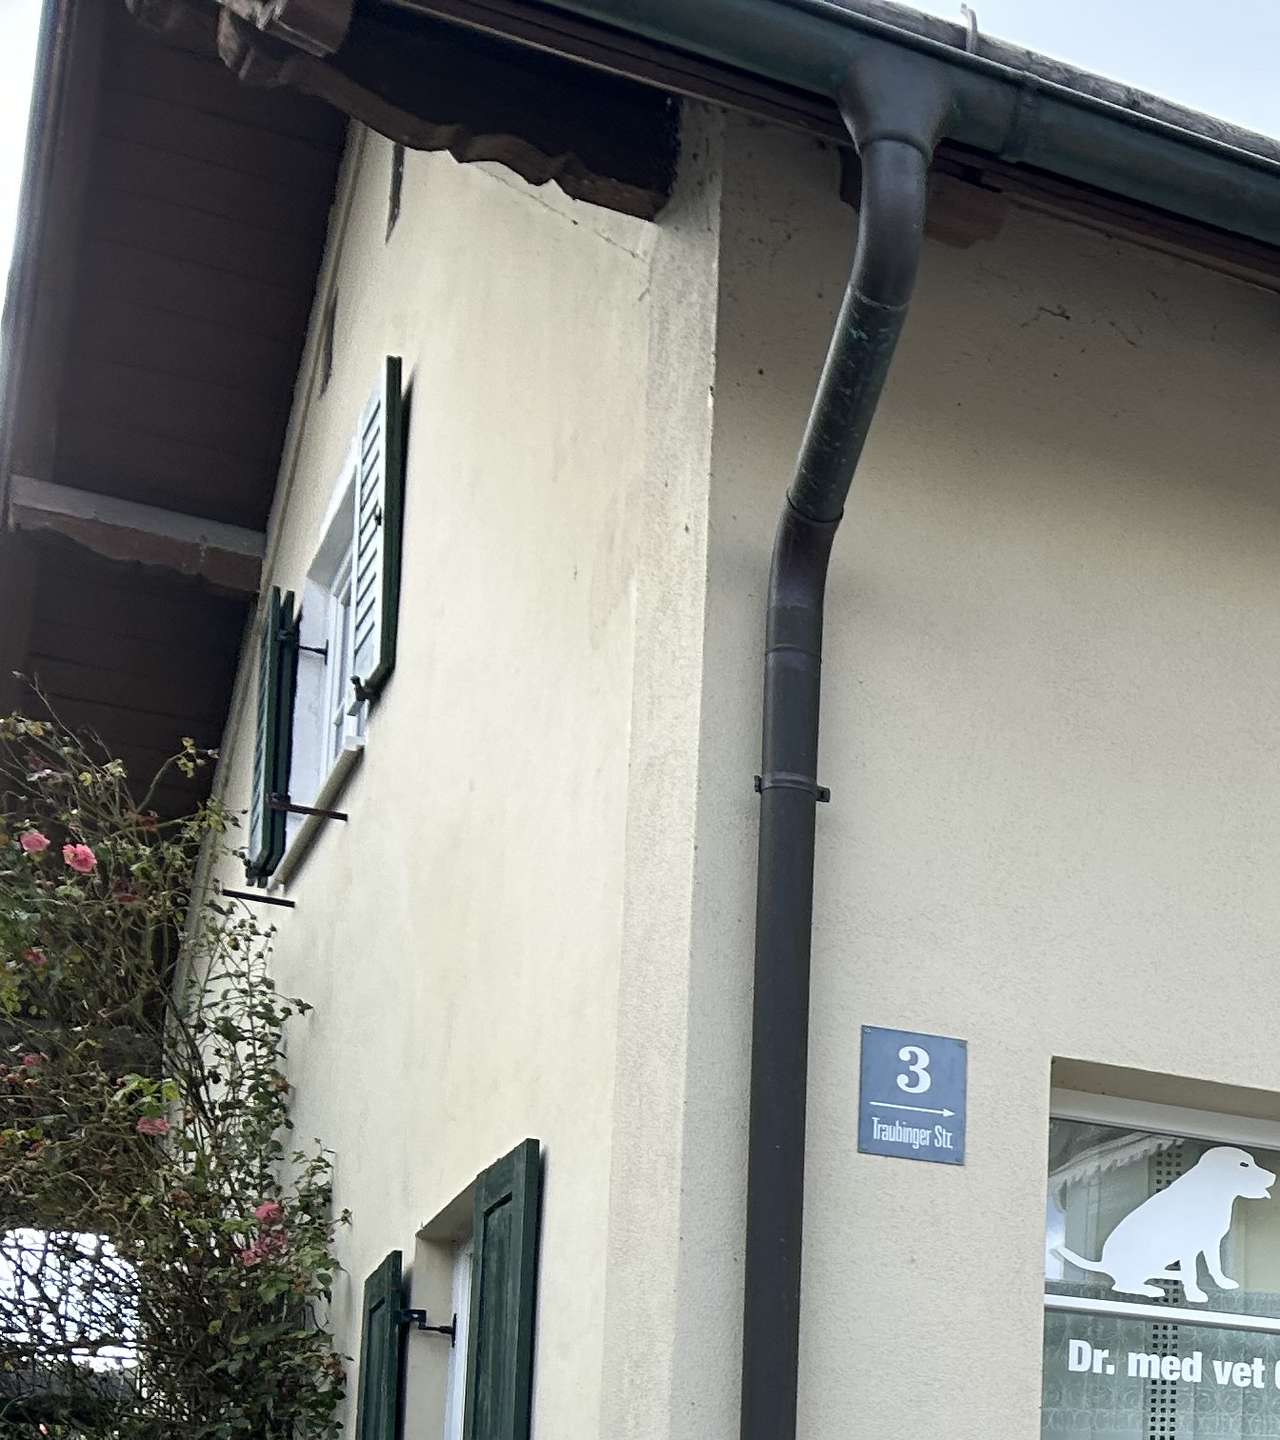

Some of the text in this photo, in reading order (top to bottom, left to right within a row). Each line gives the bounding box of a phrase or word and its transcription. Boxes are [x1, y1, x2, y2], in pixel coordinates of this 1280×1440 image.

[896, 1046, 931, 1093] 3
[871, 1117, 953, 1149] Traubinger Str.
[1067, 1339, 1115, 1376] Dr.
[1127, 1350, 1201, 1385] med
[1212, 1360, 1267, 1390] vet
